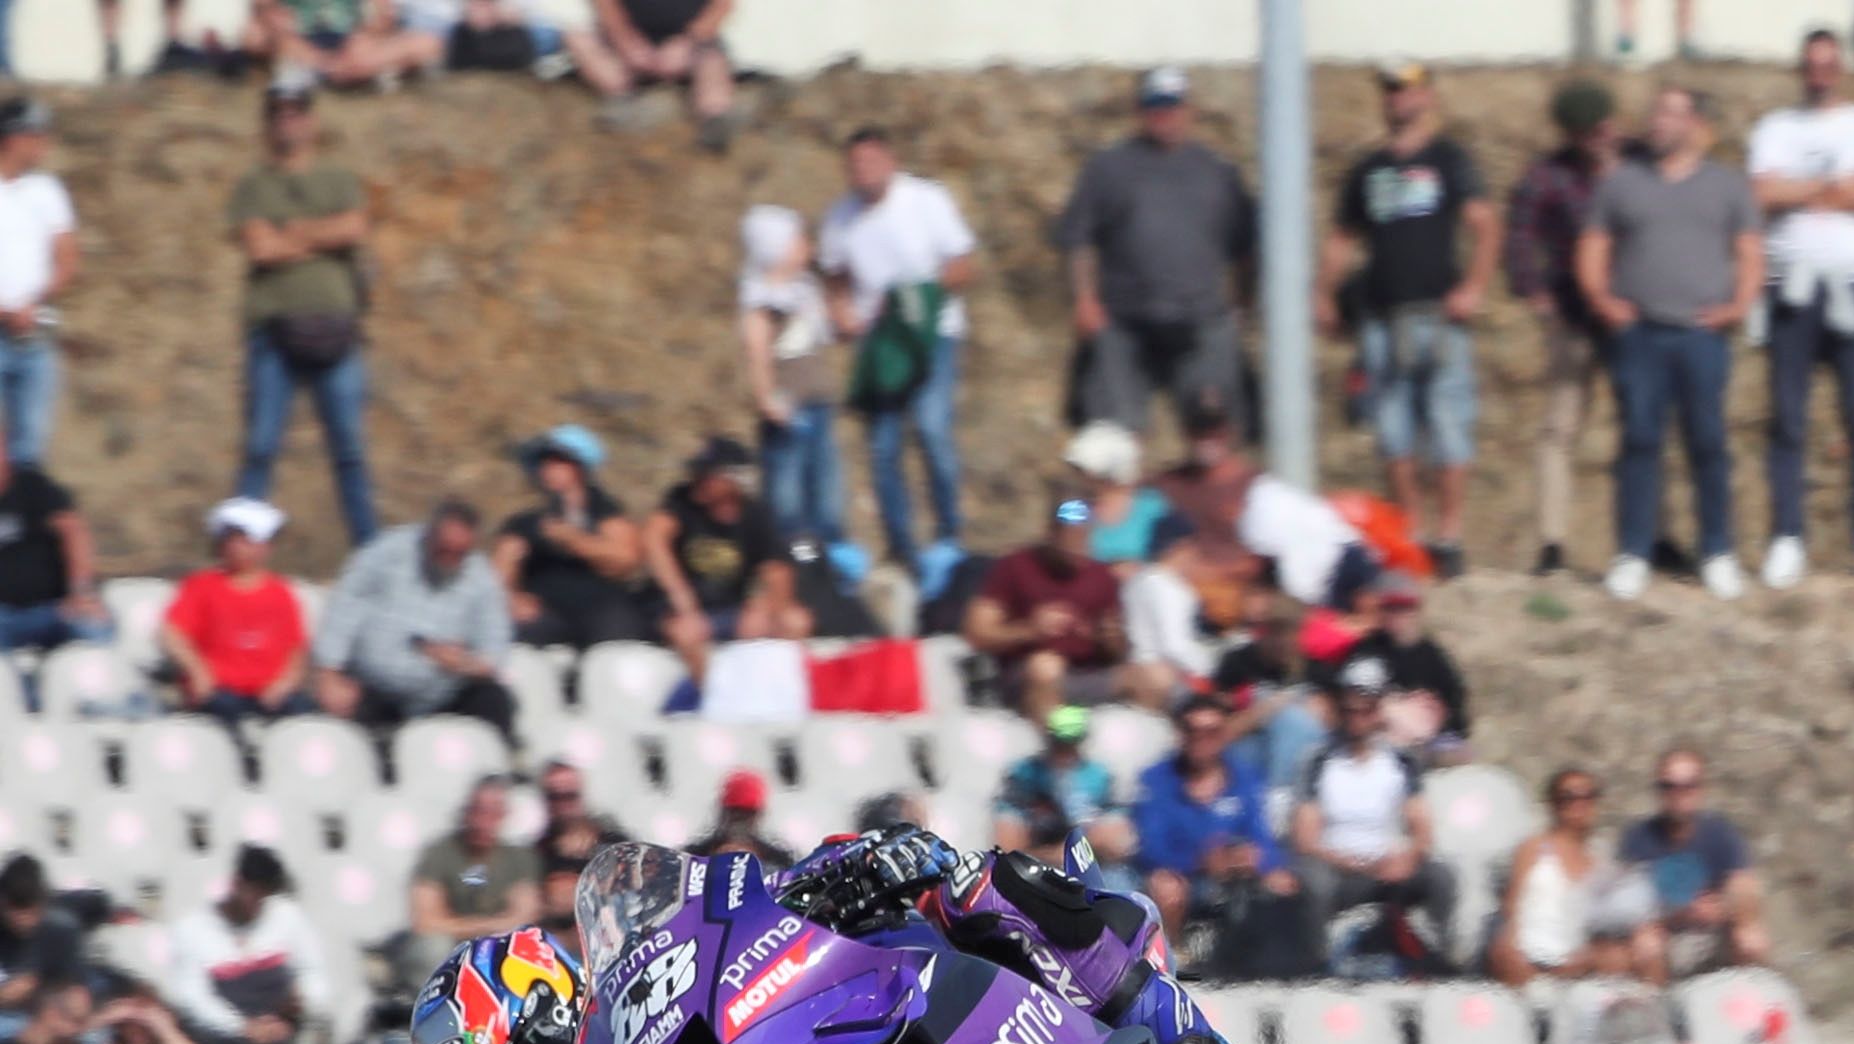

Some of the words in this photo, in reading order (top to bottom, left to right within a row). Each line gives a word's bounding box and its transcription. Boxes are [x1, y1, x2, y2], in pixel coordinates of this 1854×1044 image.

[688, 861, 707, 896] WRS
[602, 929, 674, 1005] prima
[720, 915, 802, 991] prima
[728, 957, 804, 1028] MOTUL
